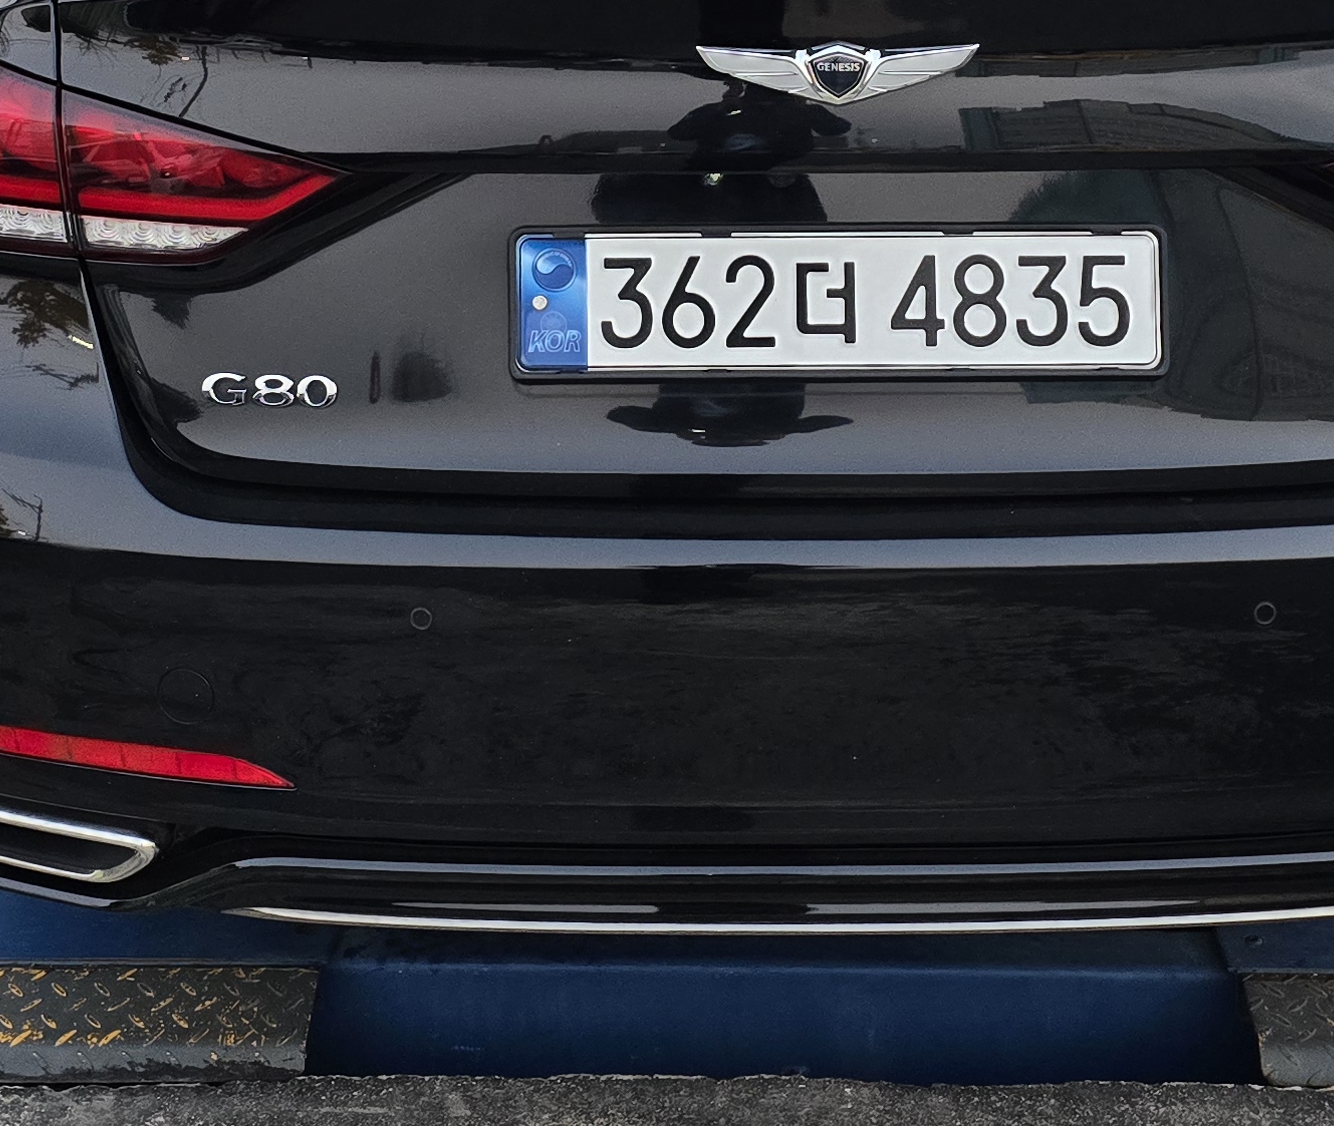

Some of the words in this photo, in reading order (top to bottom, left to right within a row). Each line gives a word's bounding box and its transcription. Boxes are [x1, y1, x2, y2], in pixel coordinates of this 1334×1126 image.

[816, 61, 861, 73] GENESIS
[601, 254, 857, 350] 362더
[890, 254, 1131, 348] 4835
[528, 329, 583, 354] KOR
[201, 372, 339, 408] G80
